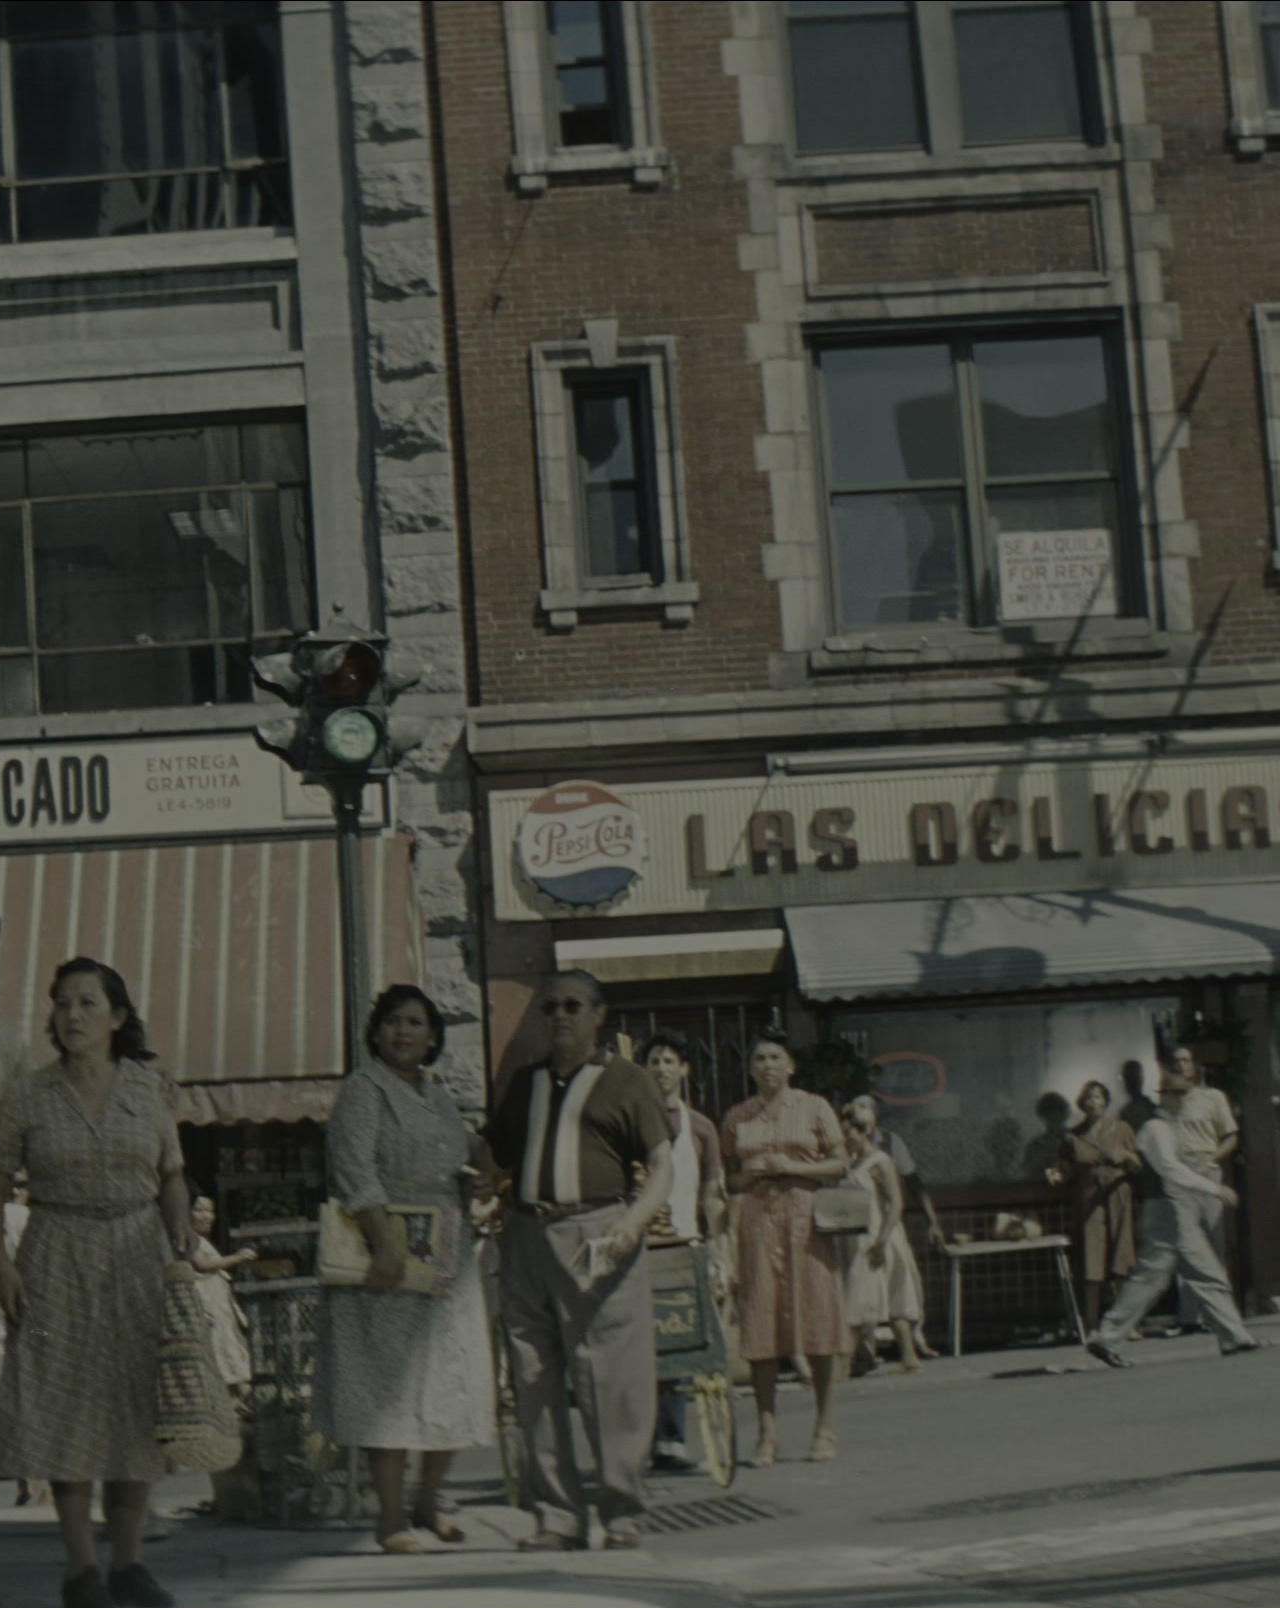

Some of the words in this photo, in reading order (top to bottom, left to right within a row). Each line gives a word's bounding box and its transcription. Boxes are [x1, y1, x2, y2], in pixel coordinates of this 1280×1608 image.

[1032, 537, 1106, 555] ALQUILA
[1007, 566, 1048, 582] FOR
[1055, 563, 1109, 580] RENT
[146, 753, 241, 773] ENTREGA
[145, 773, 242, 793] GRATUITA
[685, 806, 860, 878] LAS
[910, 785, 1272, 868] DELICIA
